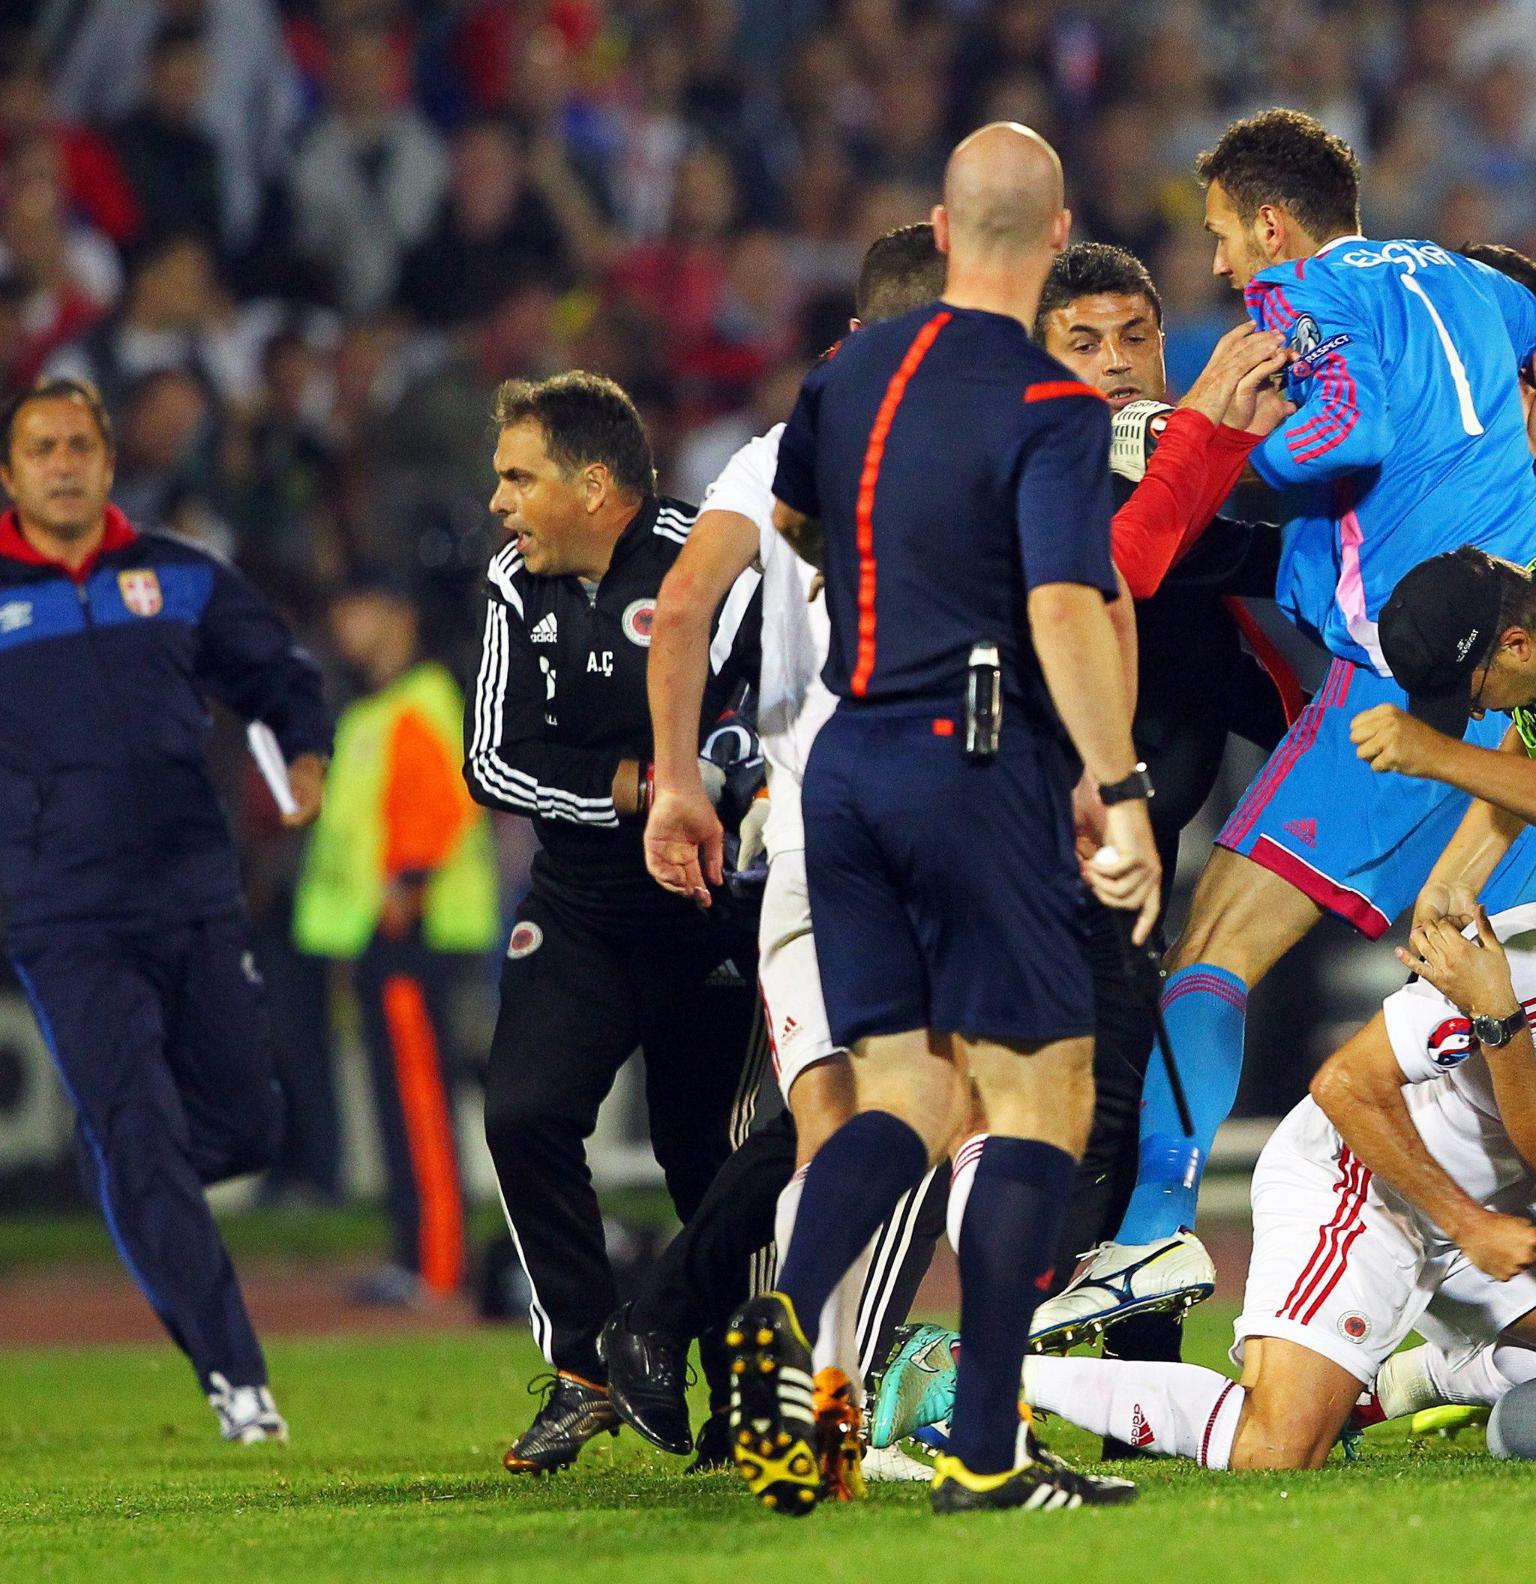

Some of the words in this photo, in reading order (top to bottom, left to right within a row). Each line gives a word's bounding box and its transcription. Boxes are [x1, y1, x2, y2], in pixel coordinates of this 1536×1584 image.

[1304, 334, 1350, 364] RESPECT
[1399, 273, 1485, 436] 1
[530, 631, 558, 643] adid
[586, 650, 614, 677] A.Ç
